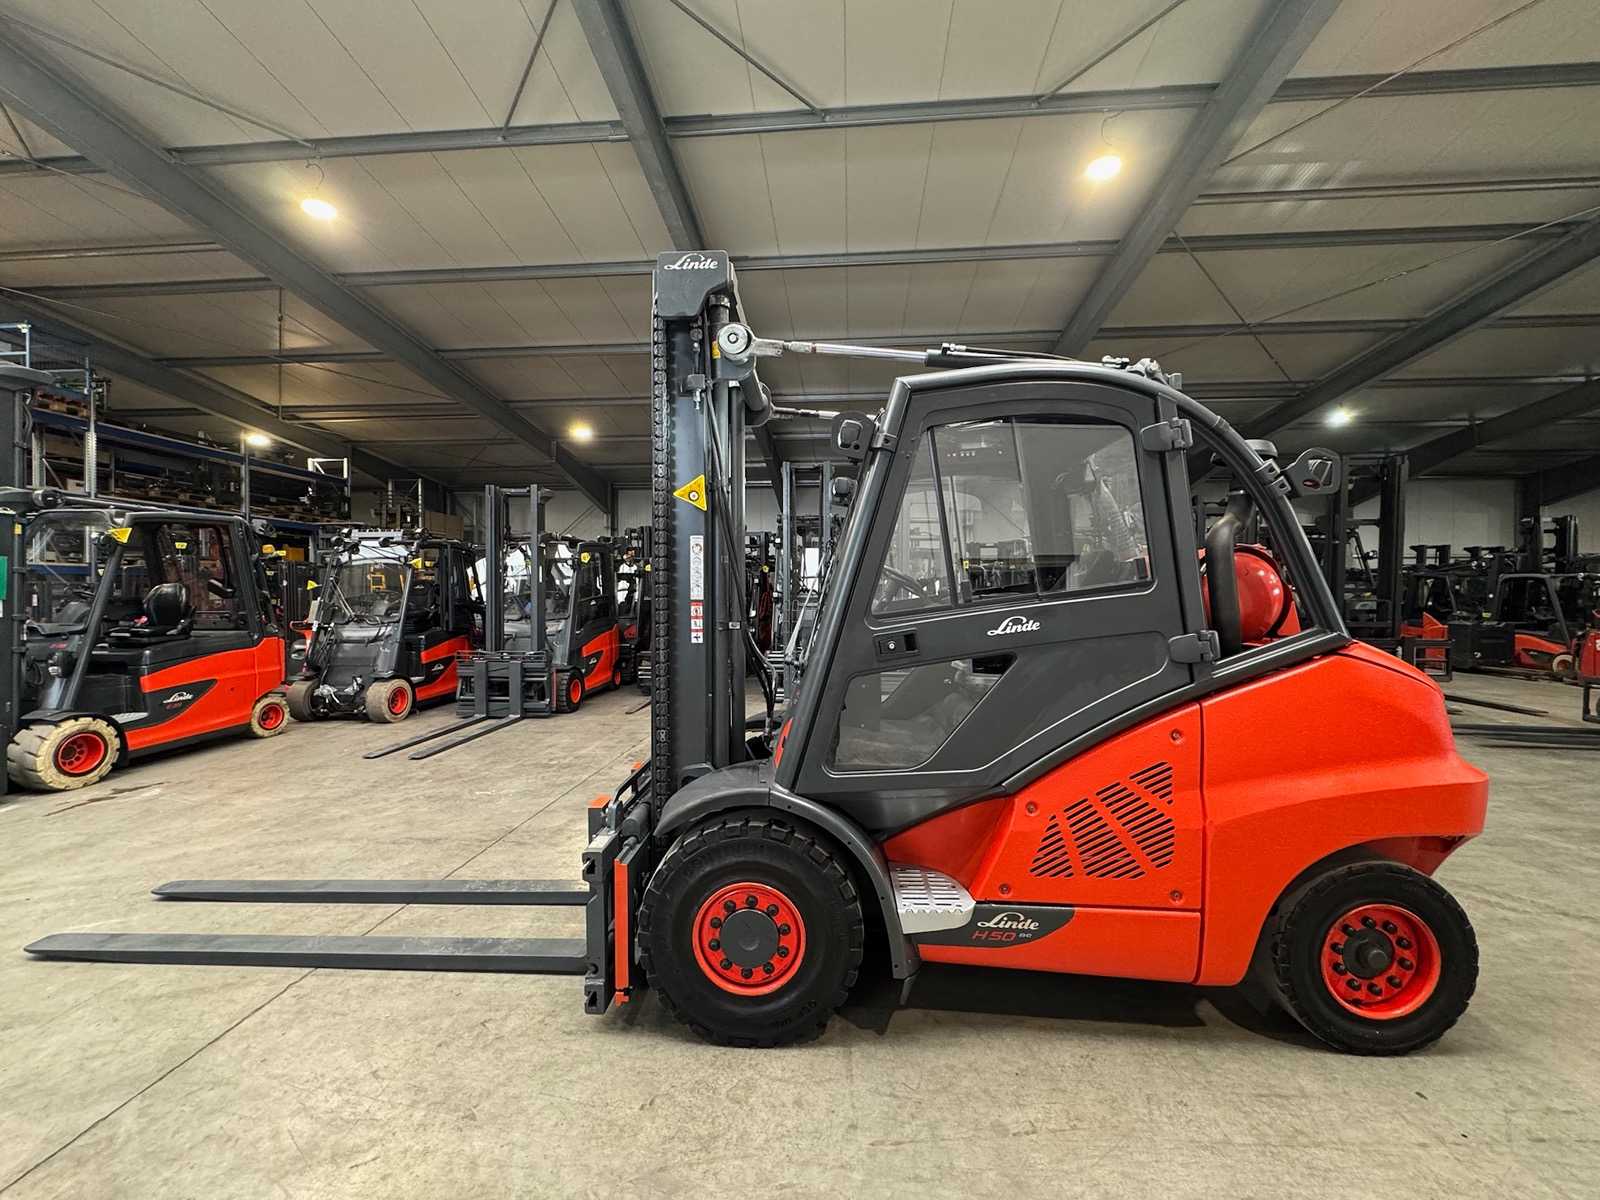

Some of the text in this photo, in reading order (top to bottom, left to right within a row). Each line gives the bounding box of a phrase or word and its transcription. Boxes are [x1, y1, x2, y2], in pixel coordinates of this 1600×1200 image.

[664, 253, 718, 270] Linde
[987, 616, 1040, 636] Linde
[977, 912, 1039, 930] Linde
